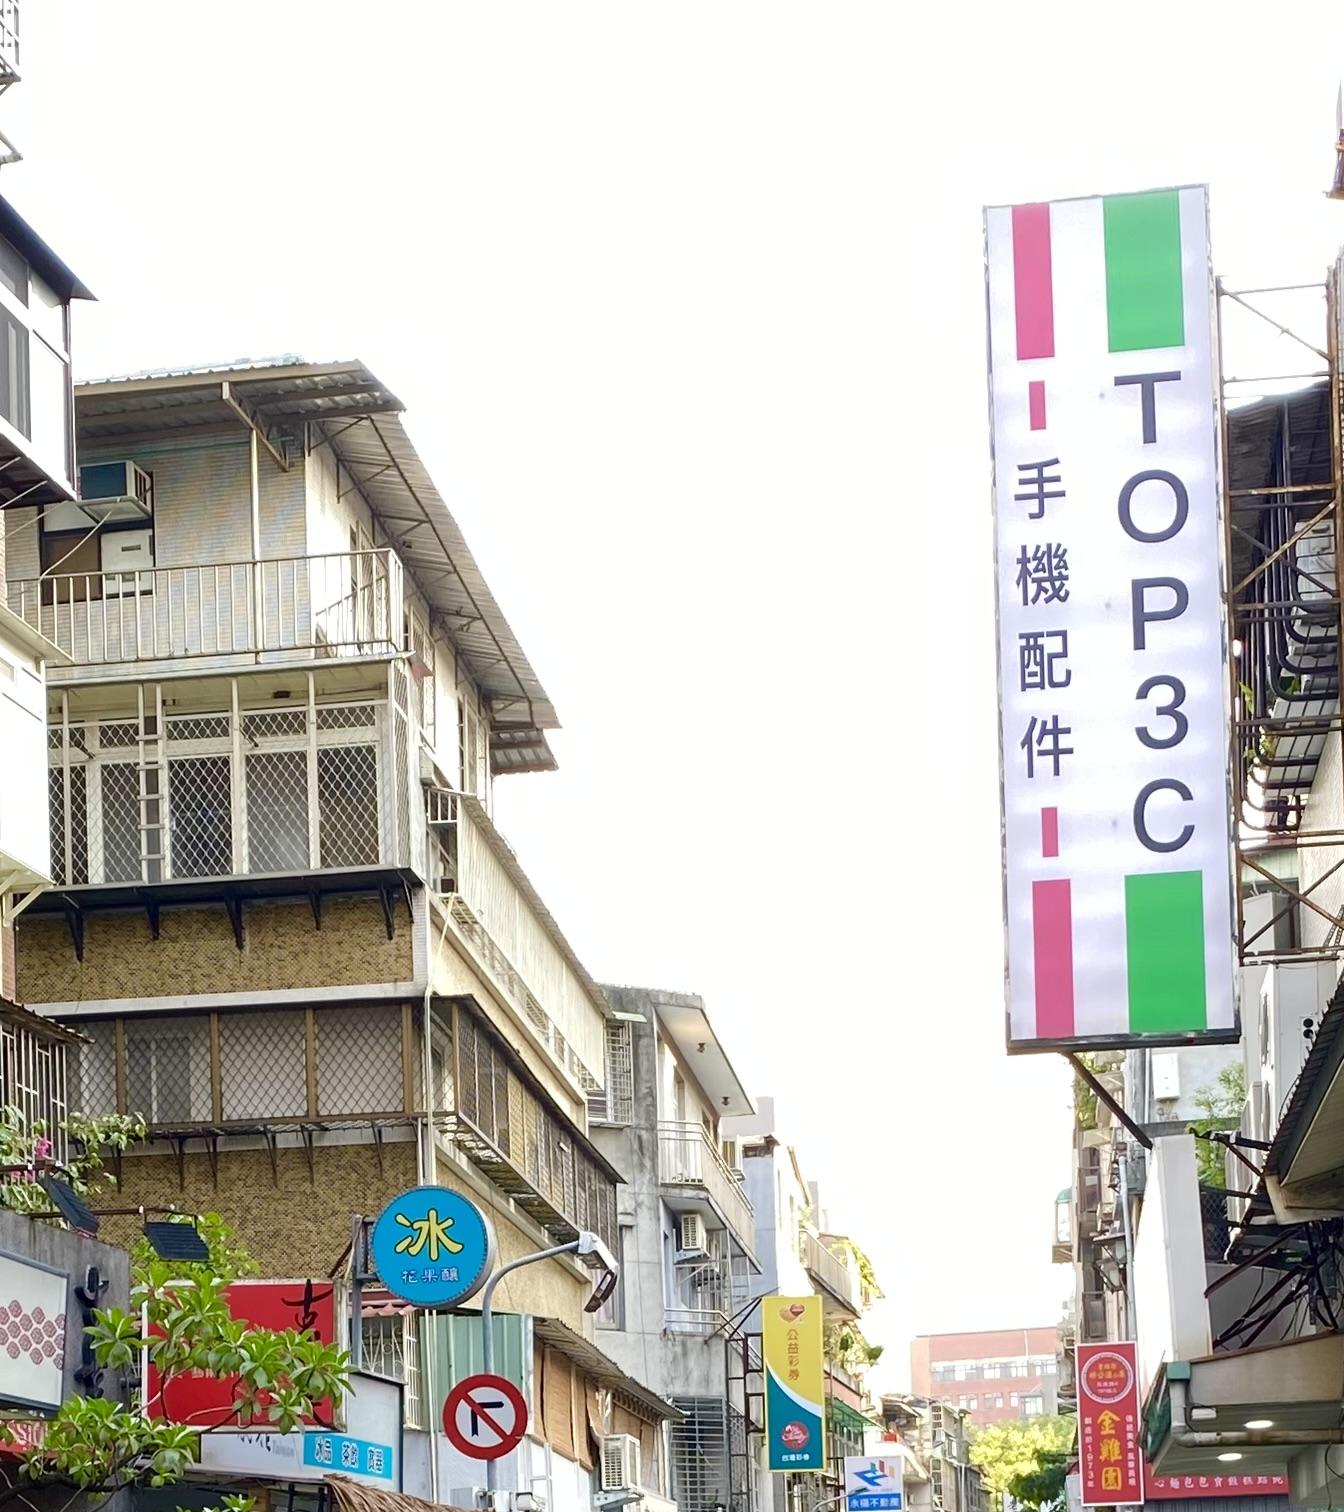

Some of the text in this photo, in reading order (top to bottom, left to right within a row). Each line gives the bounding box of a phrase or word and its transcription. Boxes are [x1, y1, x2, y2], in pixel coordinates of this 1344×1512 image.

[1014, 458, 1074, 778] 手機配件
[1114, 370, 1195, 853] TOP3C
[394, 1208, 464, 1262] 冰
